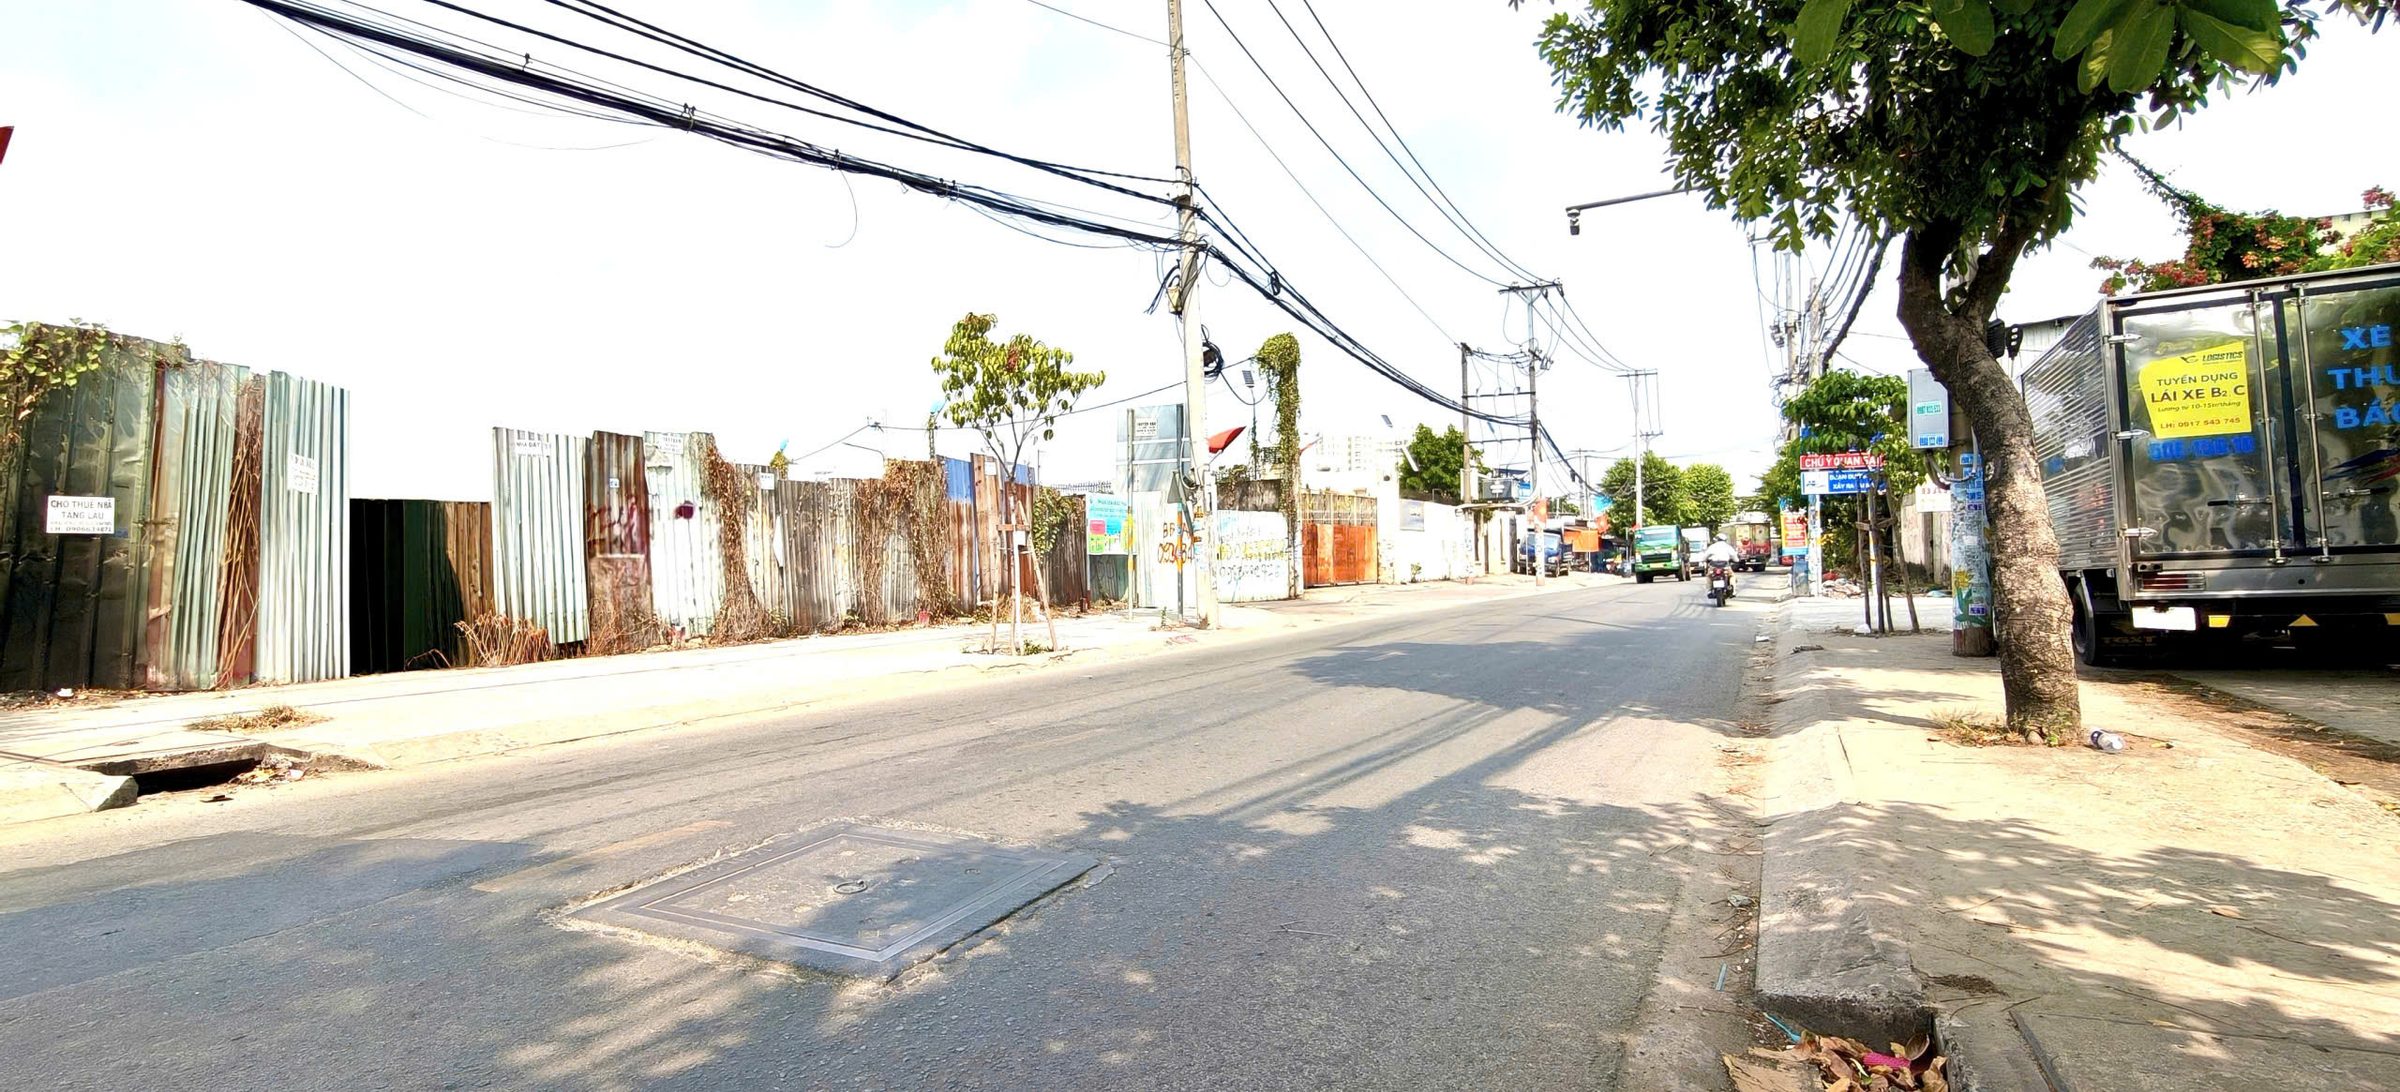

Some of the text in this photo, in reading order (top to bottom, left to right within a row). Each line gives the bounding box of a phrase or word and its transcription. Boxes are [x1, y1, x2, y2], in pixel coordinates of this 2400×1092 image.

[2341, 326, 2391, 350] XE
[2202, 351, 2243, 362] LOGISTICS
[2200, 372, 2239, 384] DỤNG
[2151, 389, 2177, 403] LÁI
[2182, 388, 2205, 400] XE
[2233, 385, 2246, 396] C
[50, 499, 70, 508] CHO
